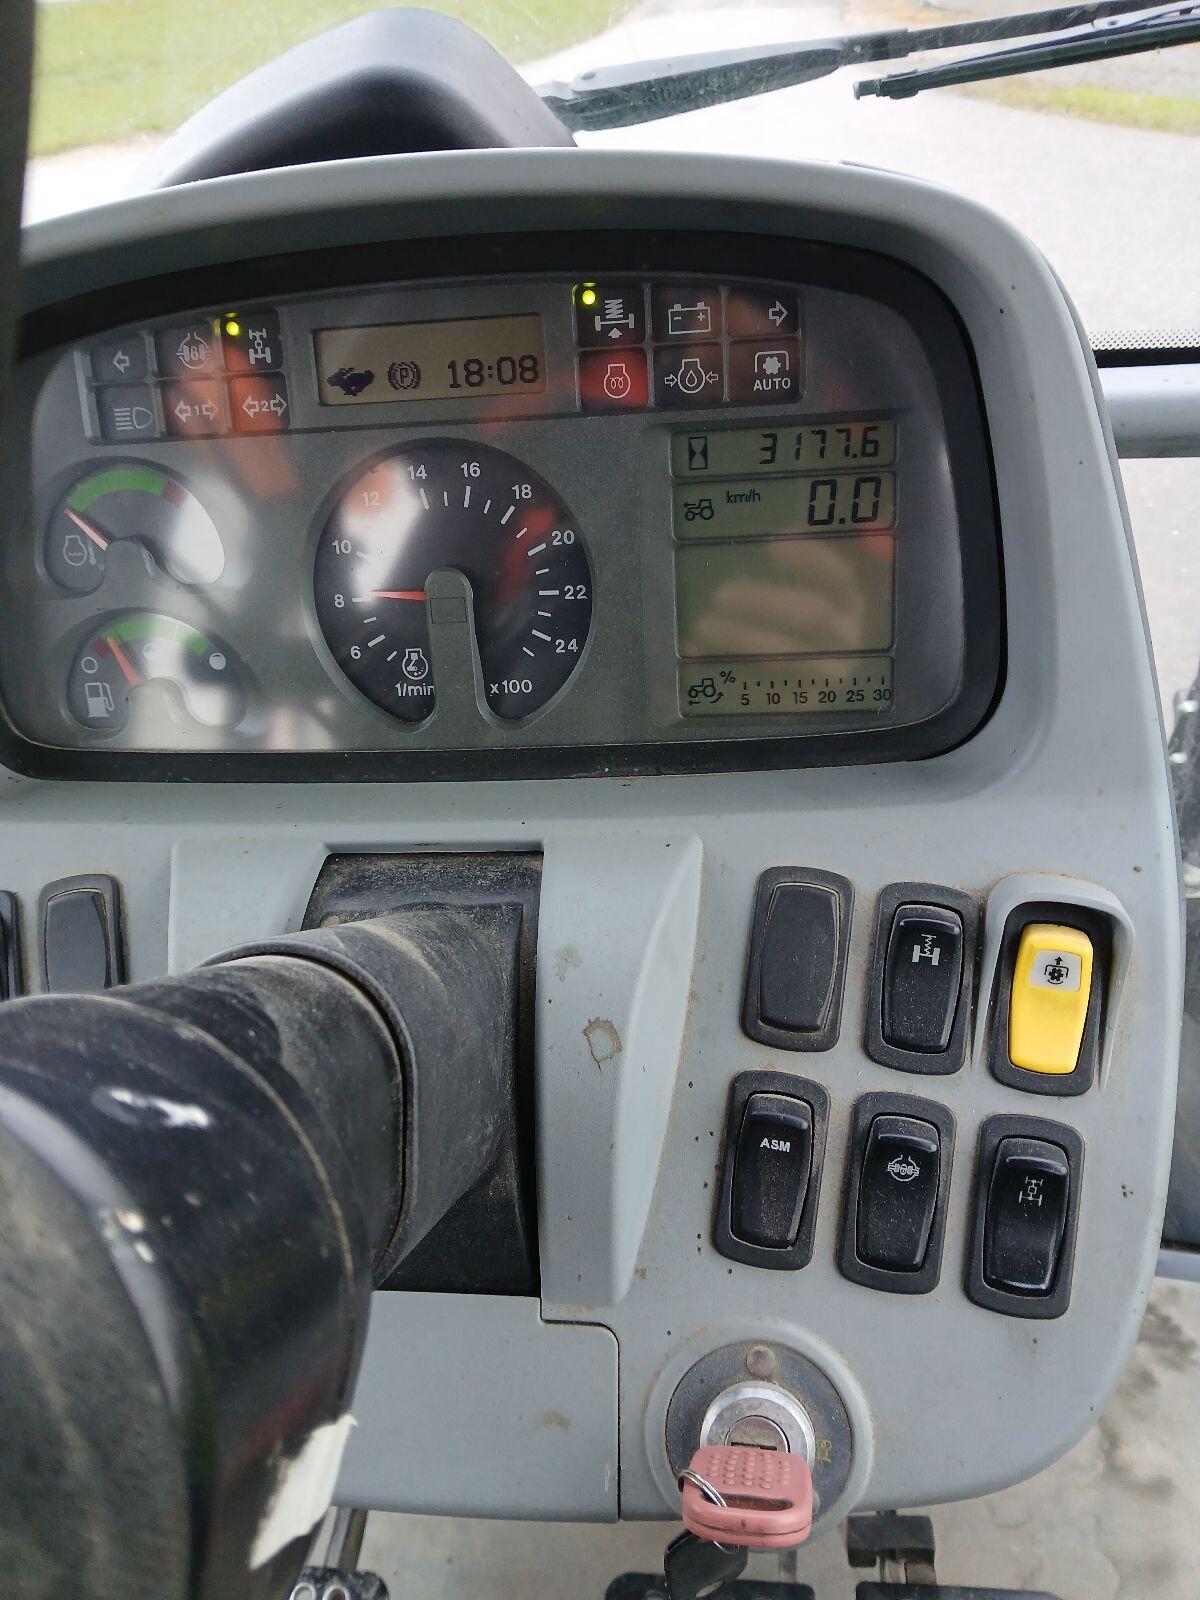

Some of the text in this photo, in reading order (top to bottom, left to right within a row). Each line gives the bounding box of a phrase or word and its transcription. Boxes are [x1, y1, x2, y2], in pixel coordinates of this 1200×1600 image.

[447, 354, 539, 388] 18:08
[753, 377, 791, 391] AUTO
[193, 404, 201, 416] 1
[259, 400, 269, 412] 2
[759, 427, 879, 464] 3177.6
[407, 464, 428, 480] 14
[461, 462, 481, 478] 16
[361, 491, 380, 506] 12
[512, 484, 532, 500] 18
[726, 489, 761, 504] km/h
[808, 477, 881, 525] 0.0
[551, 529, 575, 545] 20
[332, 539, 352, 555] 10
[564, 585, 588, 600] 22
[334, 594, 345, 608] 8
[350, 645, 361, 660] 6
[555, 638, 578, 654] 24
[741, 688, 891, 706] 5 10 15 20 25 30
[760, 1138, 790, 1152] ASM
